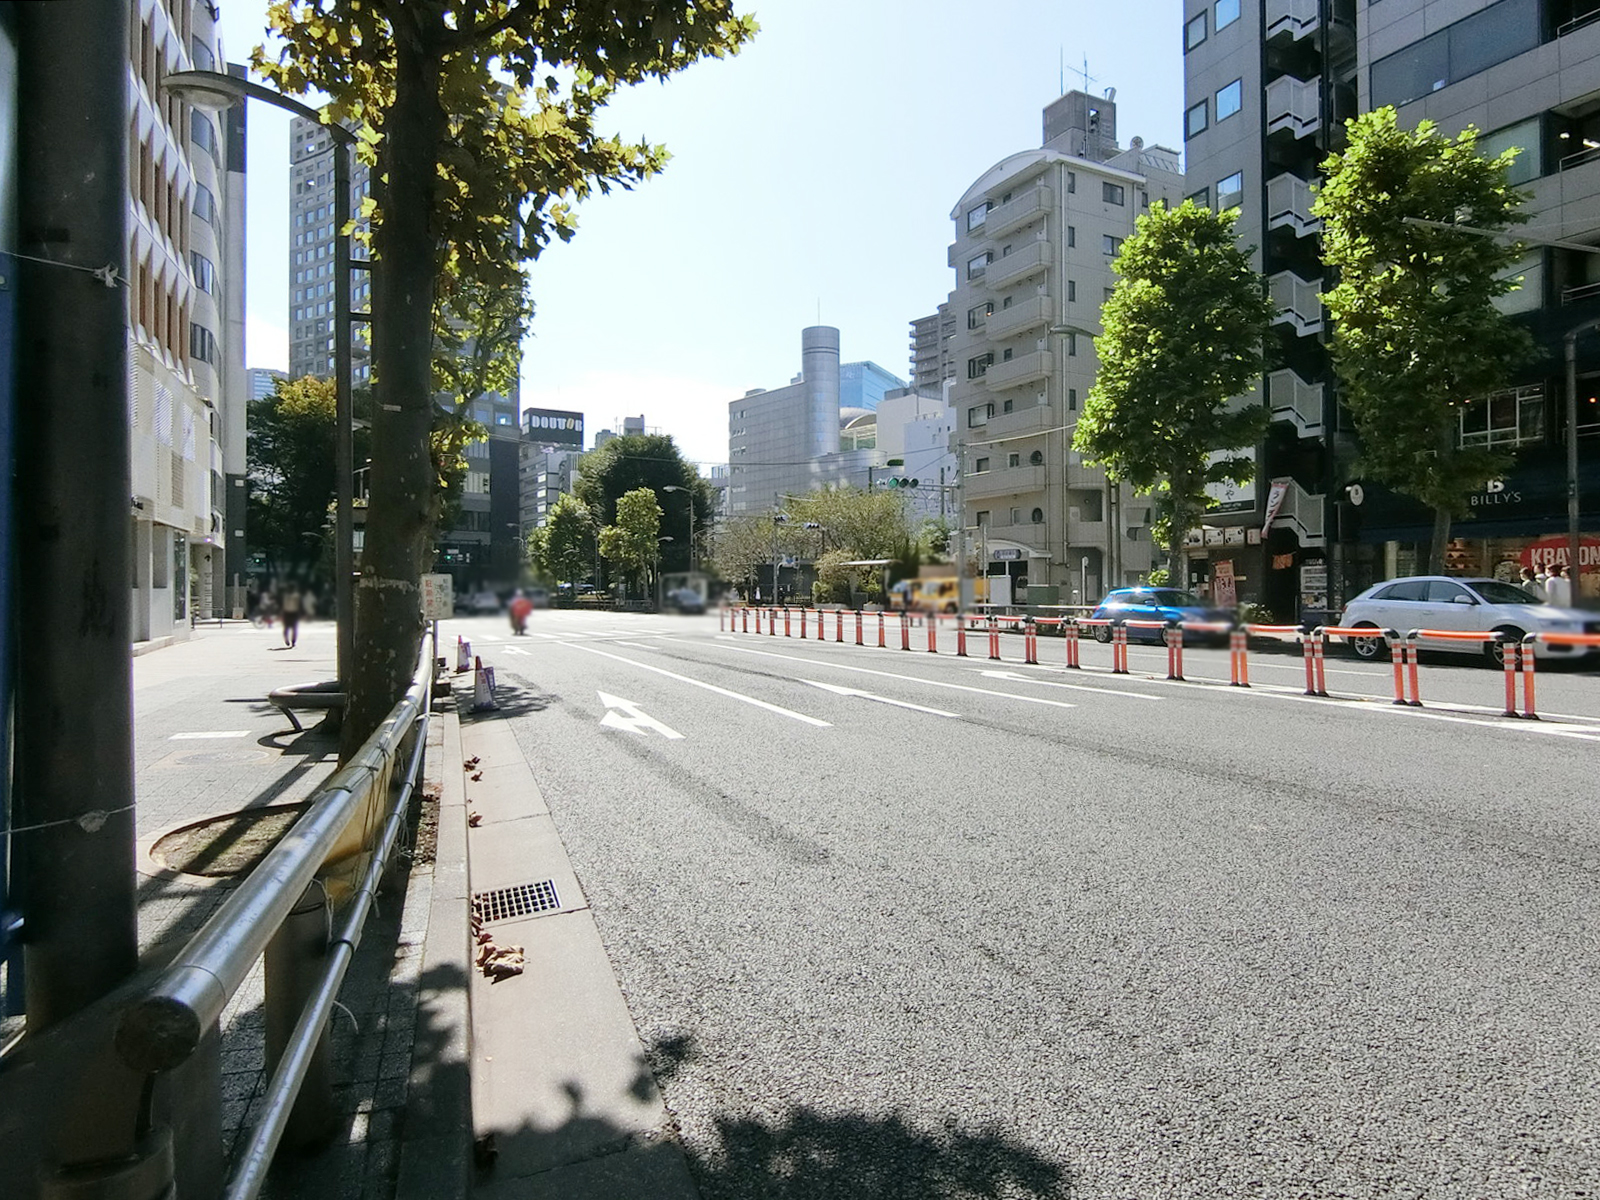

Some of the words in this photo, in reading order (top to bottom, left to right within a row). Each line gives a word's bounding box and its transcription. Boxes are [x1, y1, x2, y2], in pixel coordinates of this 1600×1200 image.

[532, 415, 583, 431] DOUTOR
[1471, 491, 1521, 506] BILLY'S
[1531, 546, 1600, 566] KRAON
